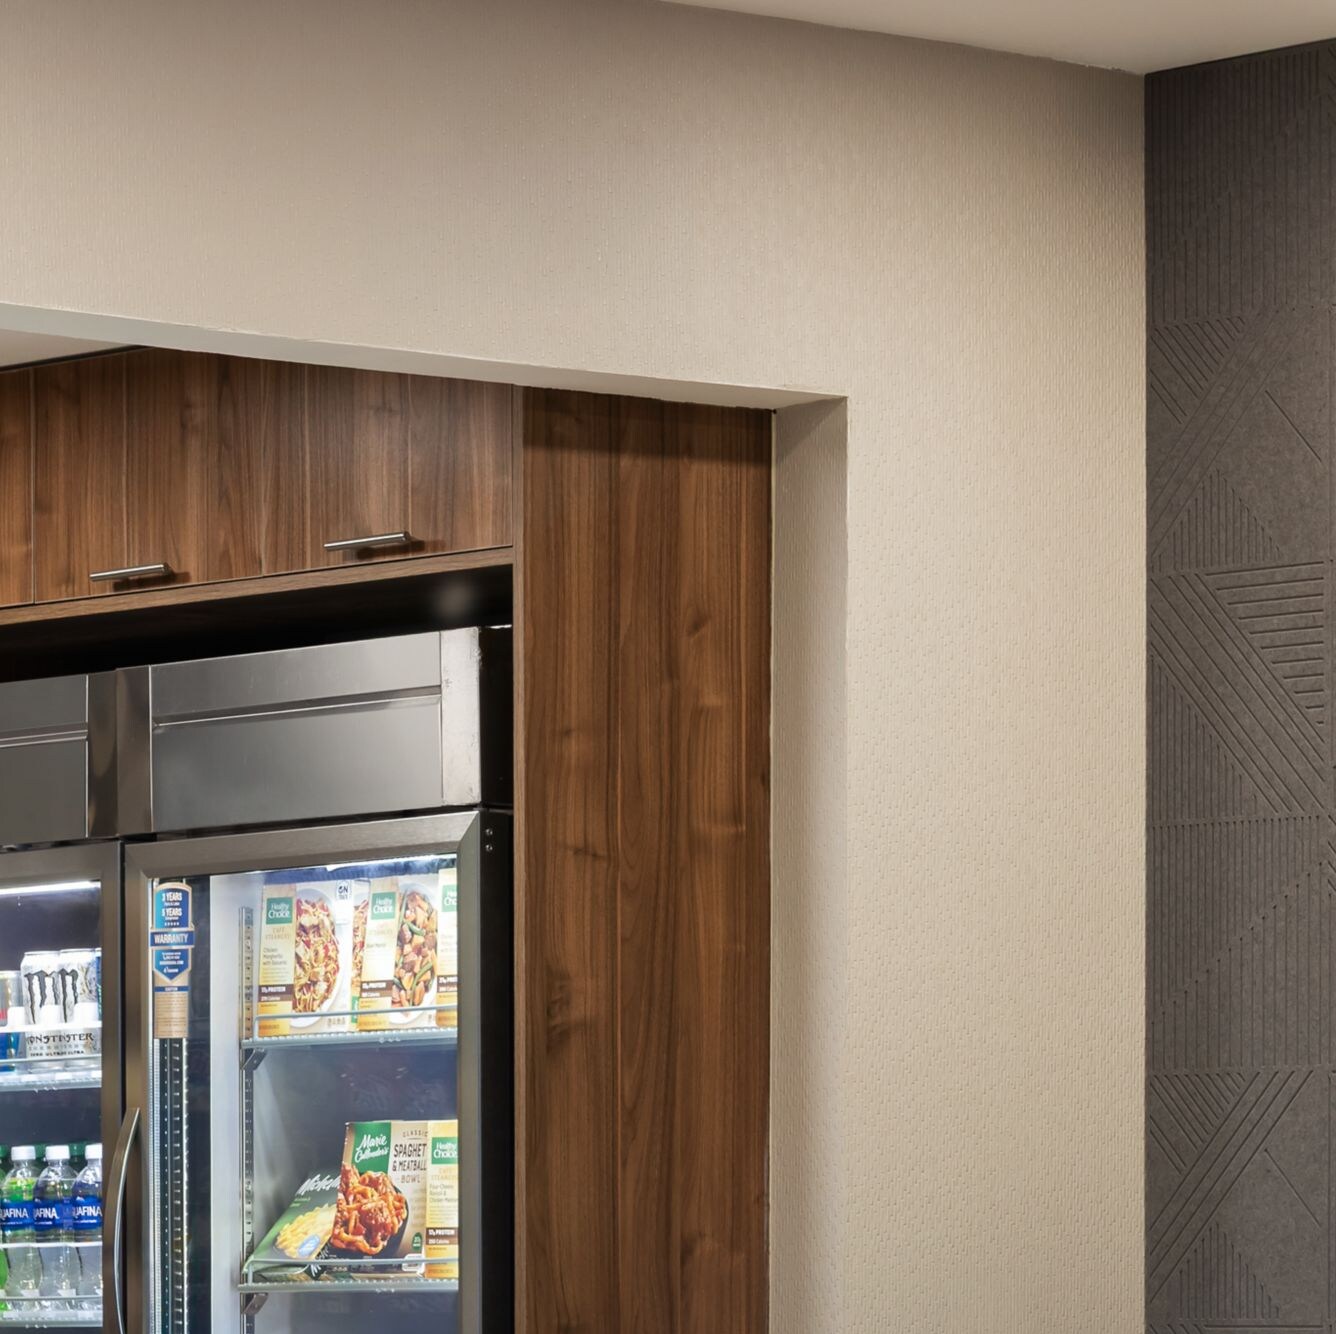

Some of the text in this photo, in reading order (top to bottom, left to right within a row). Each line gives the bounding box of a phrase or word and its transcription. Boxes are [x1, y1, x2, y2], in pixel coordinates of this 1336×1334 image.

[166, 892, 183, 902] YEARS
[166, 908, 183, 917] YEARS
[268, 909, 290, 919] Choice
[373, 904, 393, 914] Choice
[154, 933, 189, 945] WARRANTY
[357, 1134, 388, 1151] Marie
[394, 1143, 427, 1157] SPAGHET
[392, 1160, 398, 1172] &
[401, 1173, 421, 1184] BOWL
